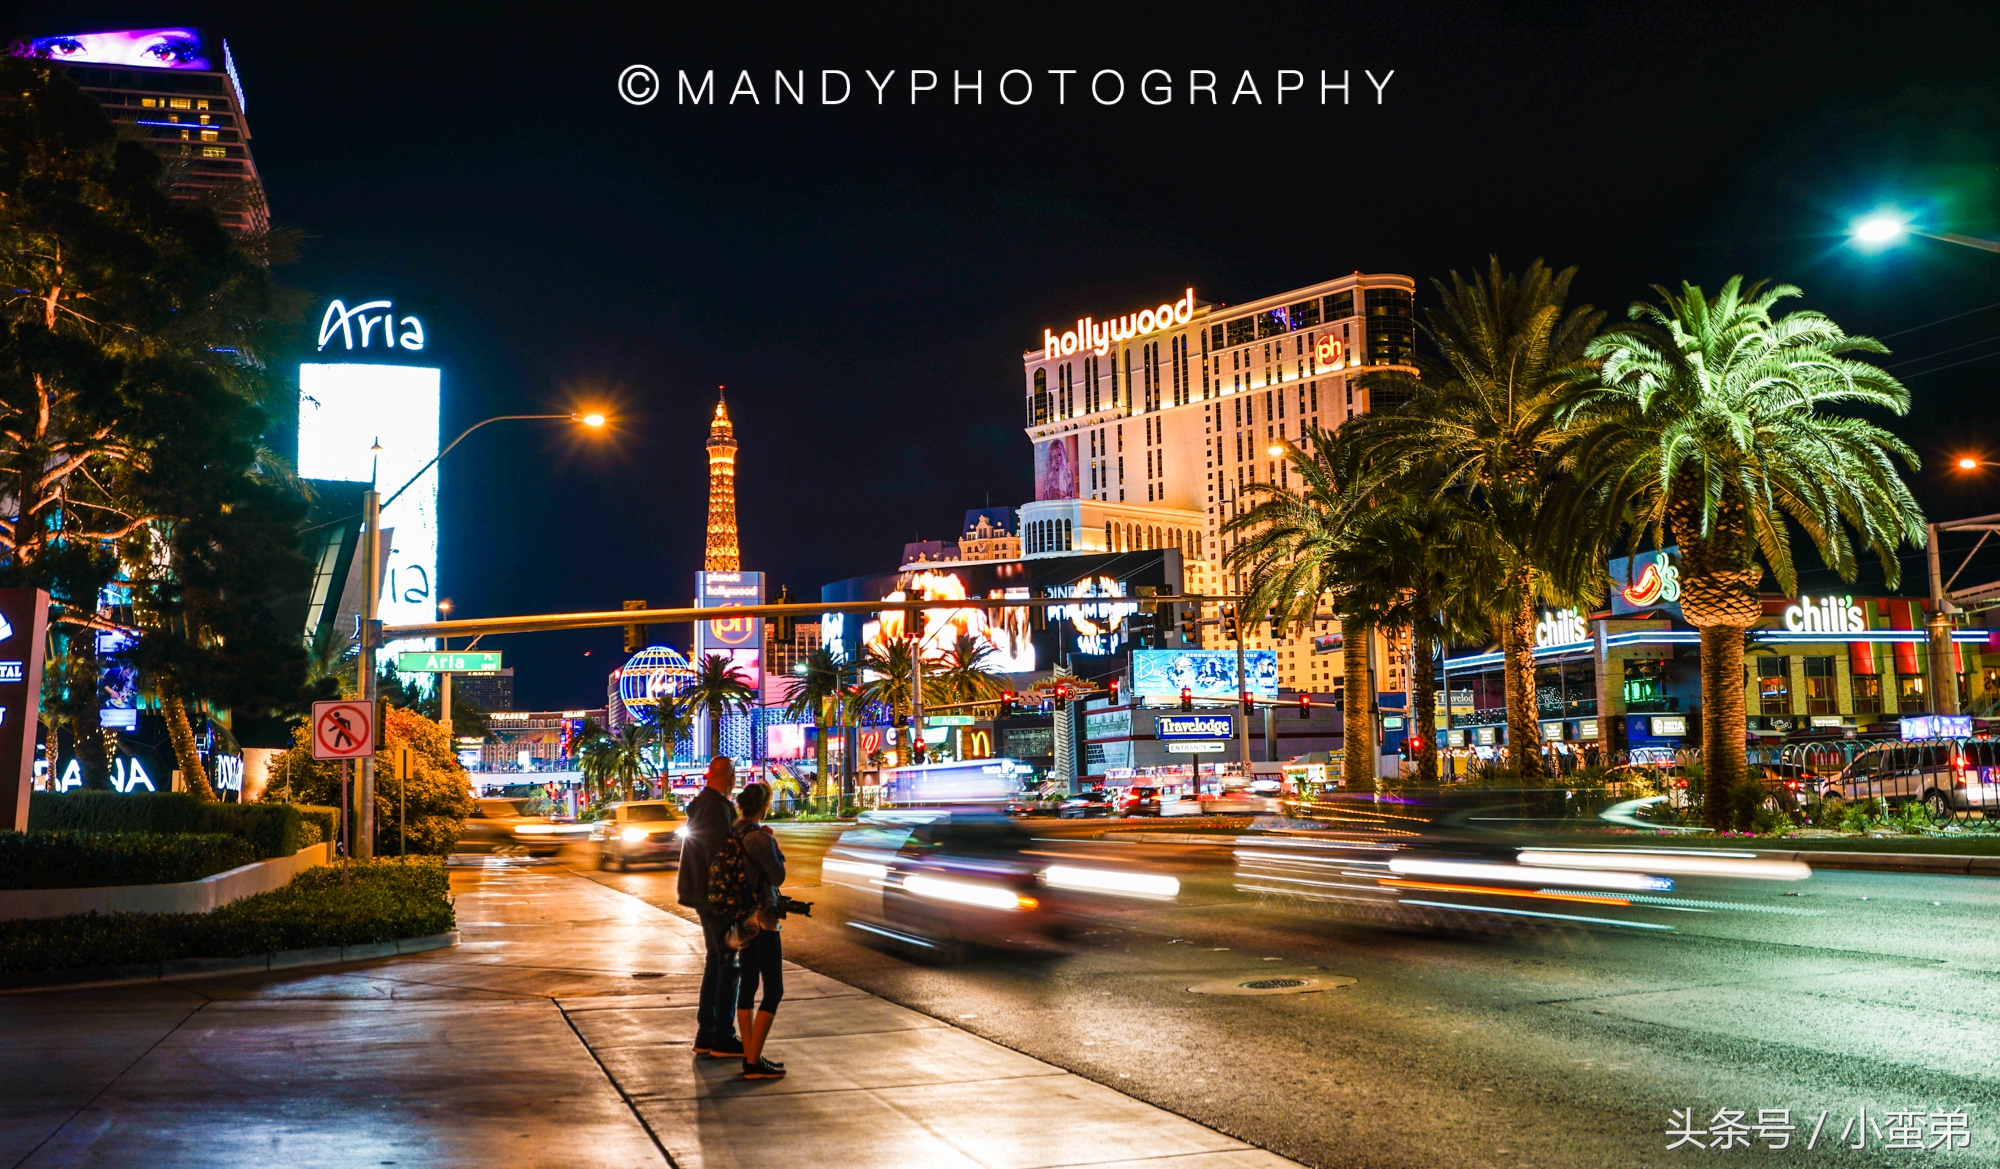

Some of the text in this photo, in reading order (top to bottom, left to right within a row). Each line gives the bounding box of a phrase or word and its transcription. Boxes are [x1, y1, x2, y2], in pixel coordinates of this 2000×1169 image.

[317, 299, 425, 352] Aria
[1043, 287, 1194, 361] hollywood
[706, 572, 741, 584] planet
[706, 585, 758, 598] hollywood
[1784, 594, 1866, 633] chili's
[1535, 605, 1587, 647] chili's
[425, 655, 466, 670] Aria
[480, 663, 497, 671] 1000
[490, 712, 530, 720] TREASURE
[941, 717, 960, 726] Aria
[1160, 717, 1231, 736] Travelodge
[1170, 744, 1208, 752] ENTRANCE
[982, 764, 1034, 775] TACO BELL
